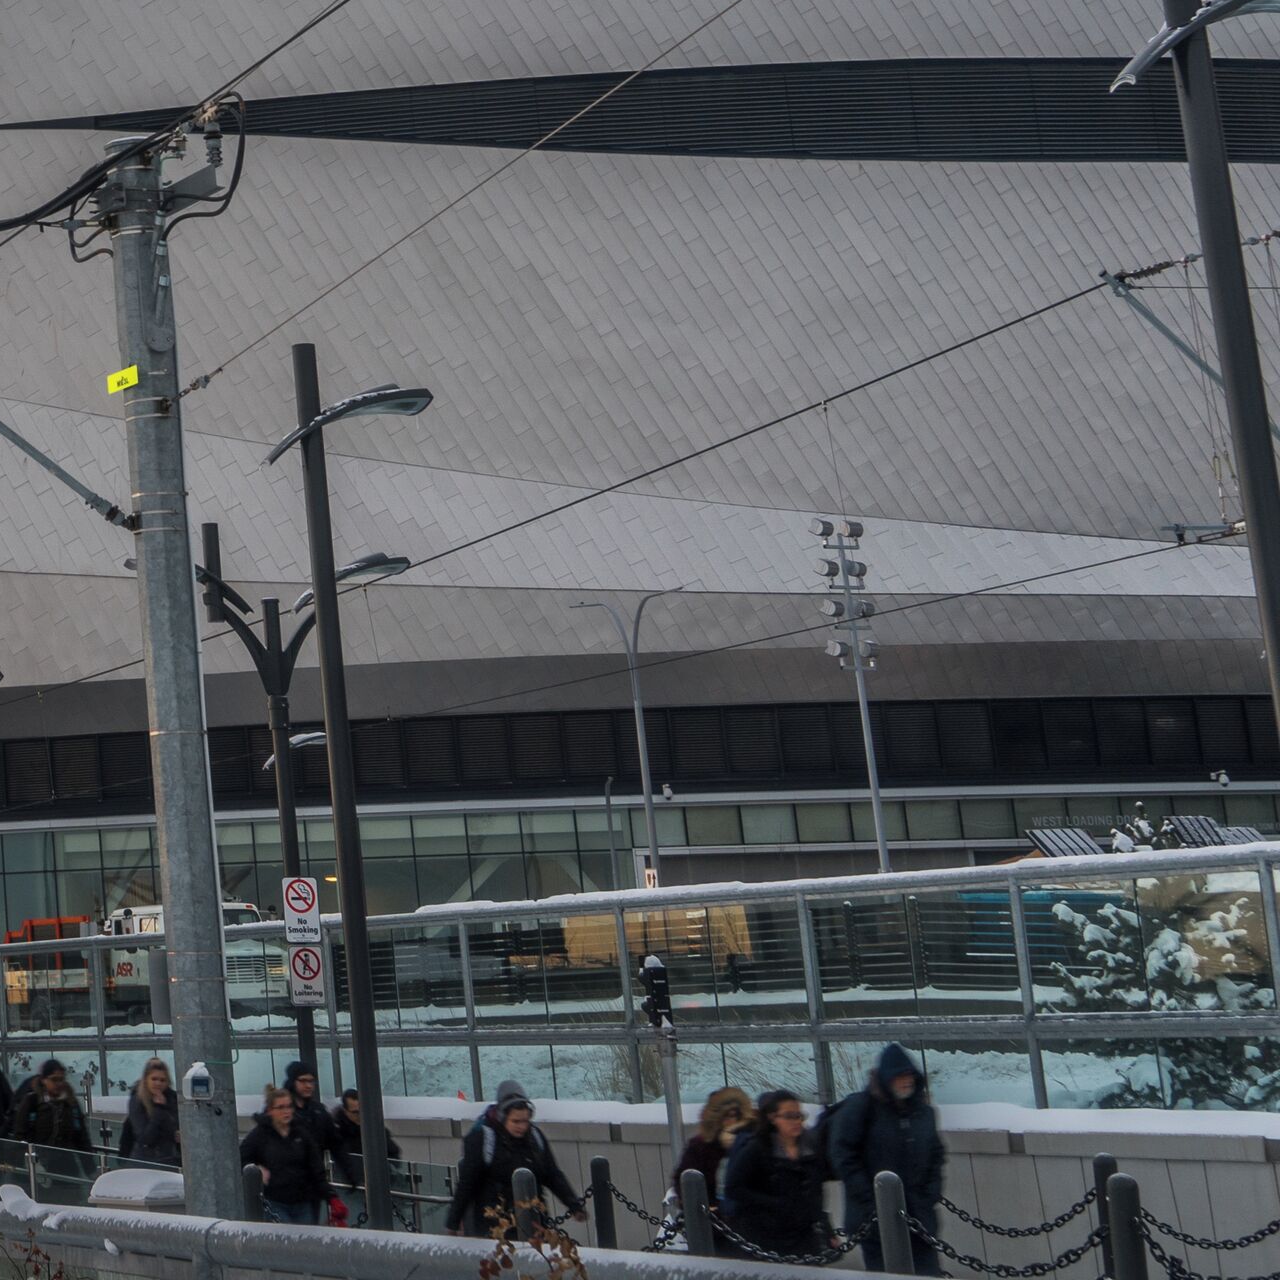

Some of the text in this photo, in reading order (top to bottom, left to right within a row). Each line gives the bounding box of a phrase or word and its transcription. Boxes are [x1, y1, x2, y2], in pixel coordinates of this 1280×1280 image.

[1031, 815, 1064, 827] WEST
[1066, 815, 1113, 827] LOADING
[297, 917, 308, 925] No
[287, 926, 319, 936] Smoking
[116, 961, 134, 977] ASR
[294, 990, 323, 998] Loitering
